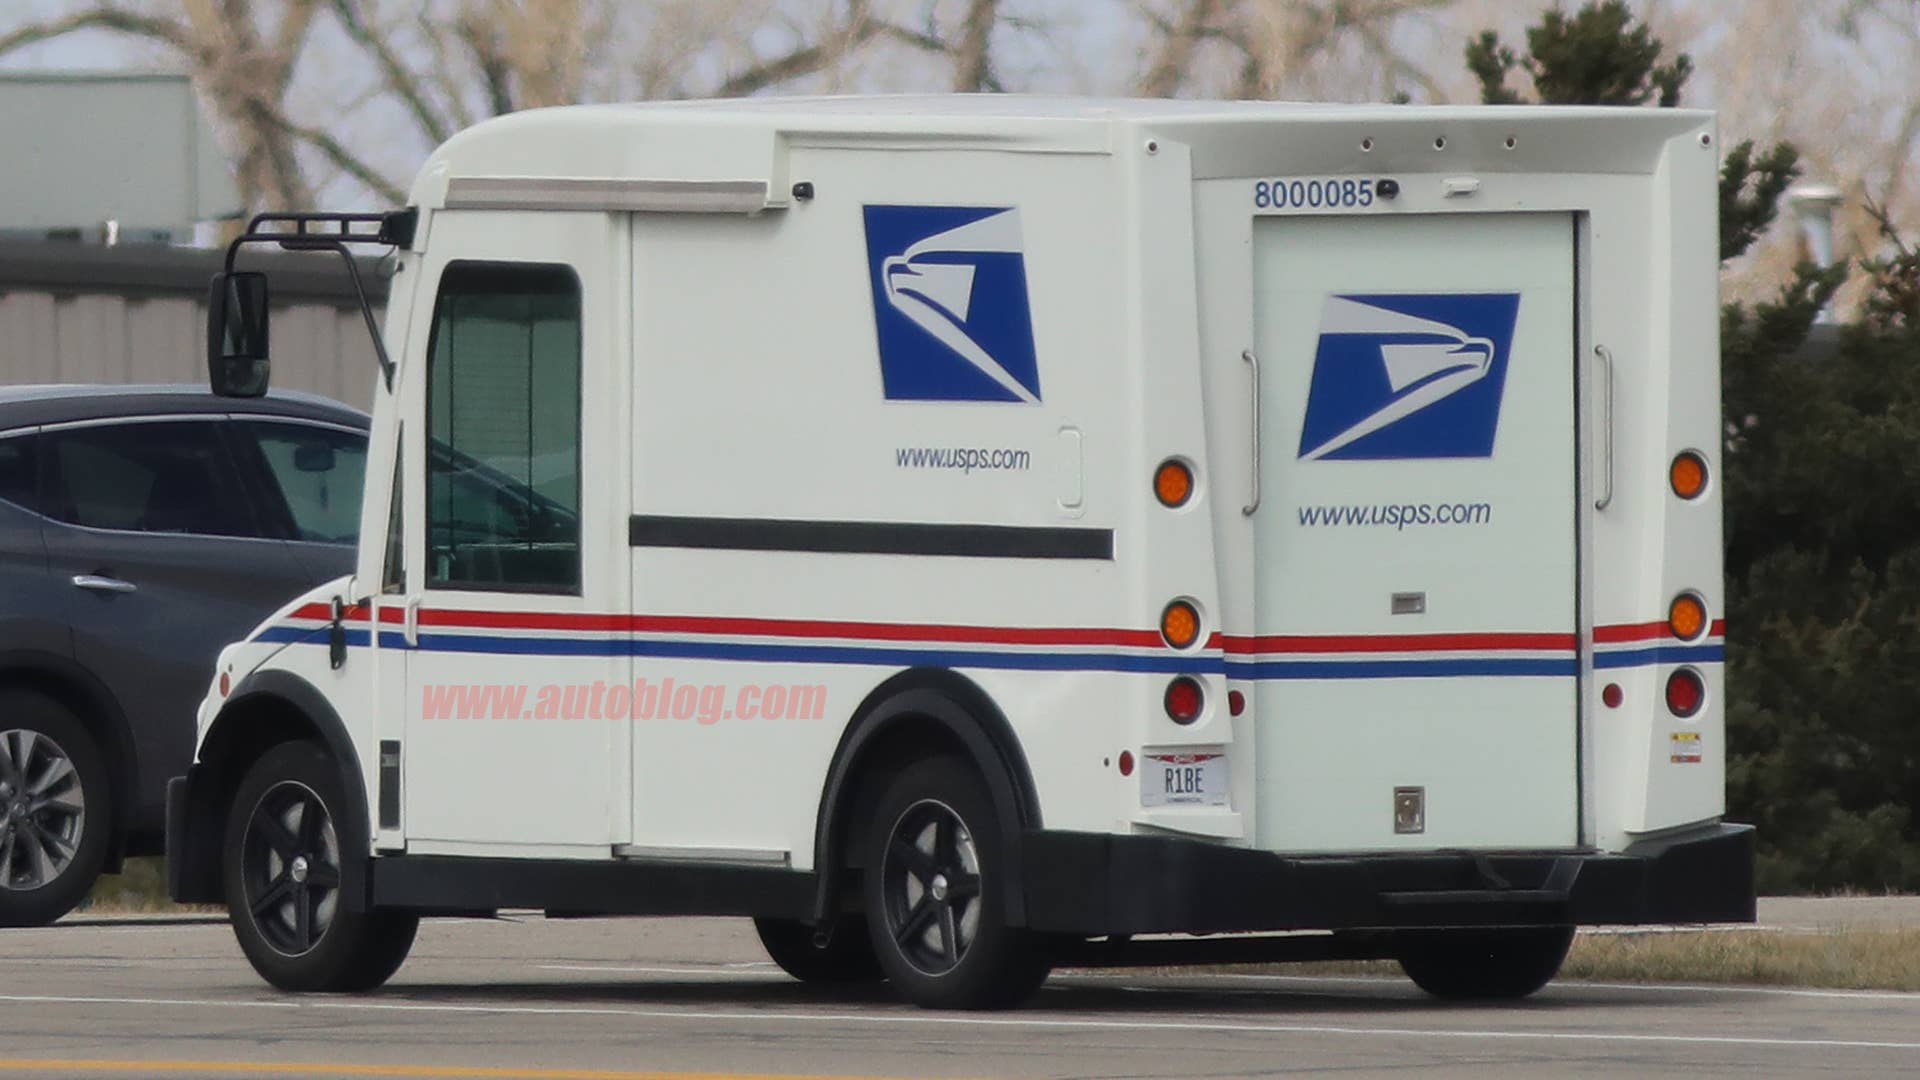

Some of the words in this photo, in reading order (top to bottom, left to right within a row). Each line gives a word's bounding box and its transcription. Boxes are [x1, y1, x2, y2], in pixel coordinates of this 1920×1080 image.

[1255, 180, 1373, 208] 8000085
[896, 448, 1030, 475] www.usps.com
[1298, 502, 1491, 531] www.usps.com
